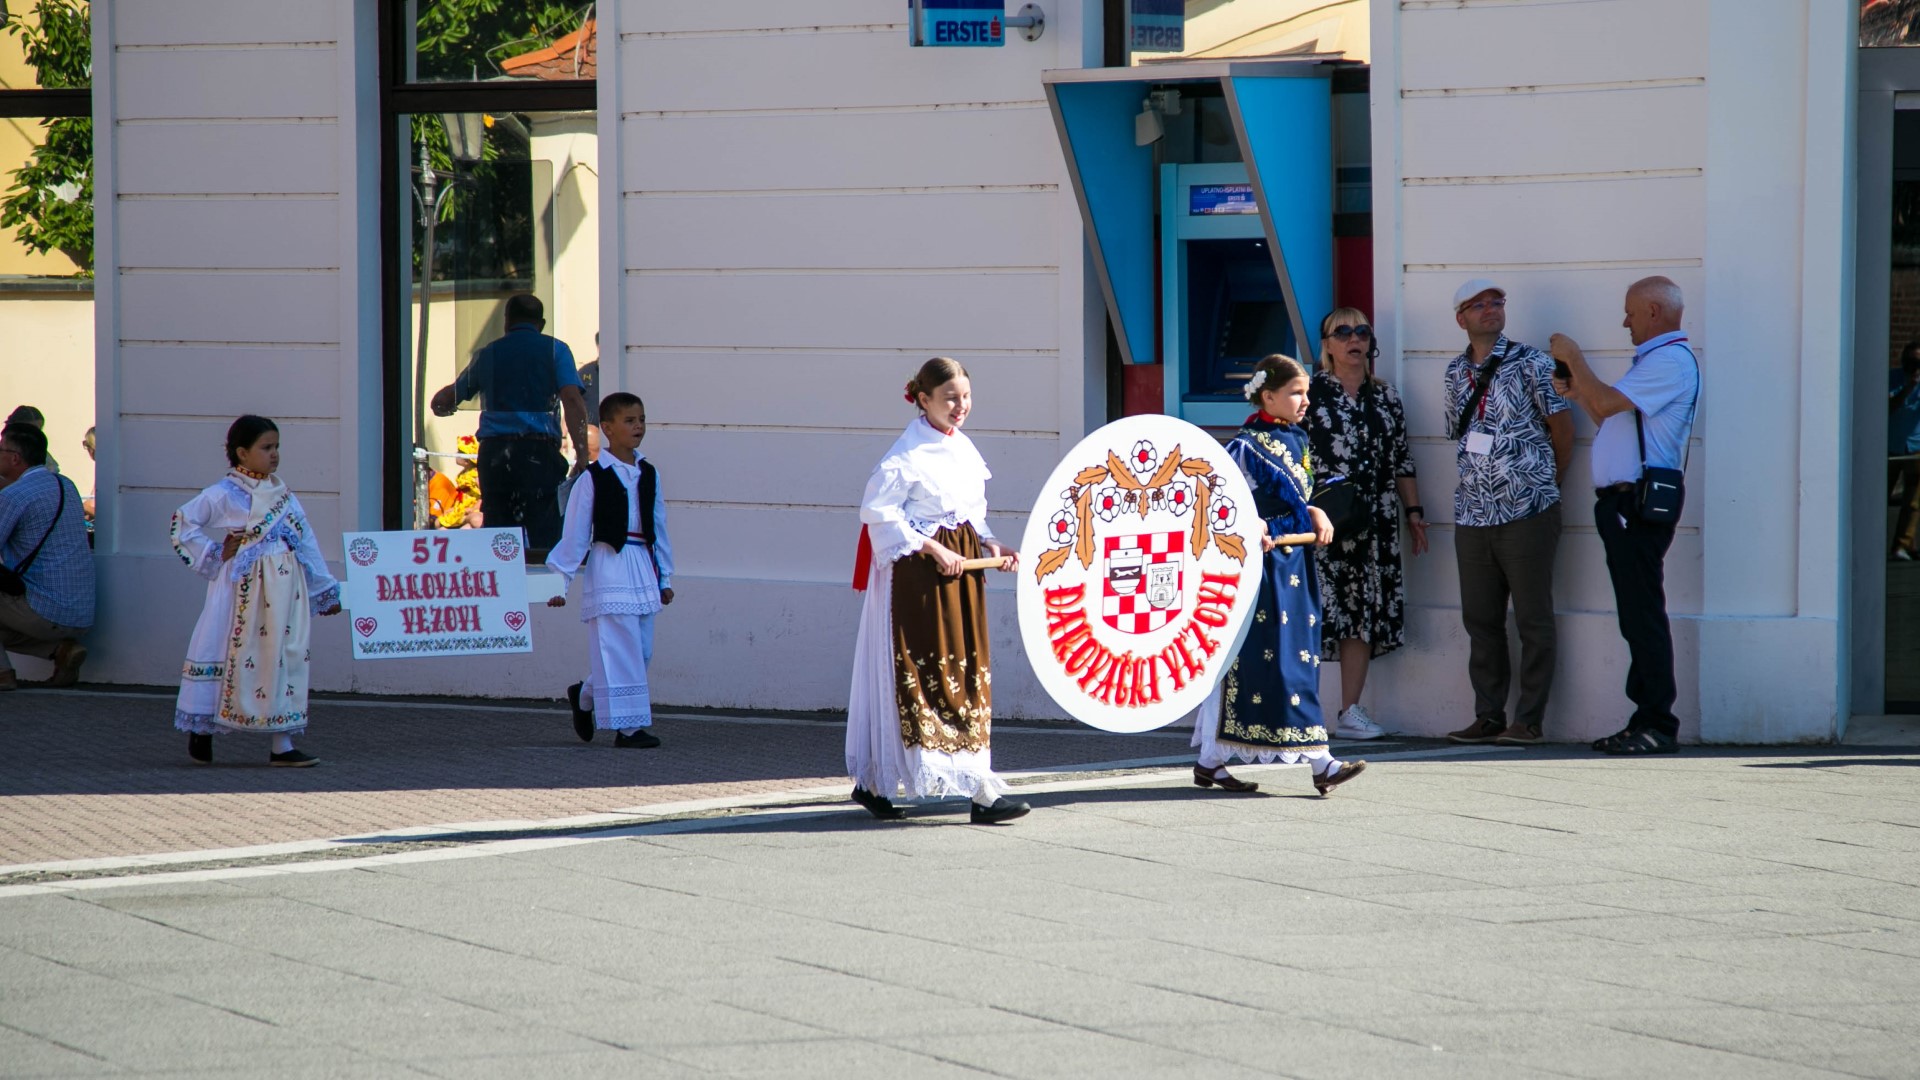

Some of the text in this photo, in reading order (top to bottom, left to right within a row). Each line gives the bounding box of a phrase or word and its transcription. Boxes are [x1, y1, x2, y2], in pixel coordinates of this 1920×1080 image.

[936, 20, 989, 42] ERSTE
[412, 536, 463, 565] 57.
[375, 566, 500, 601] ĐAKOVAČKI
[399, 604, 483, 635] VEZOVI
[1043, 570, 1241, 708] ĐAKOVAČKI VEZOVI
